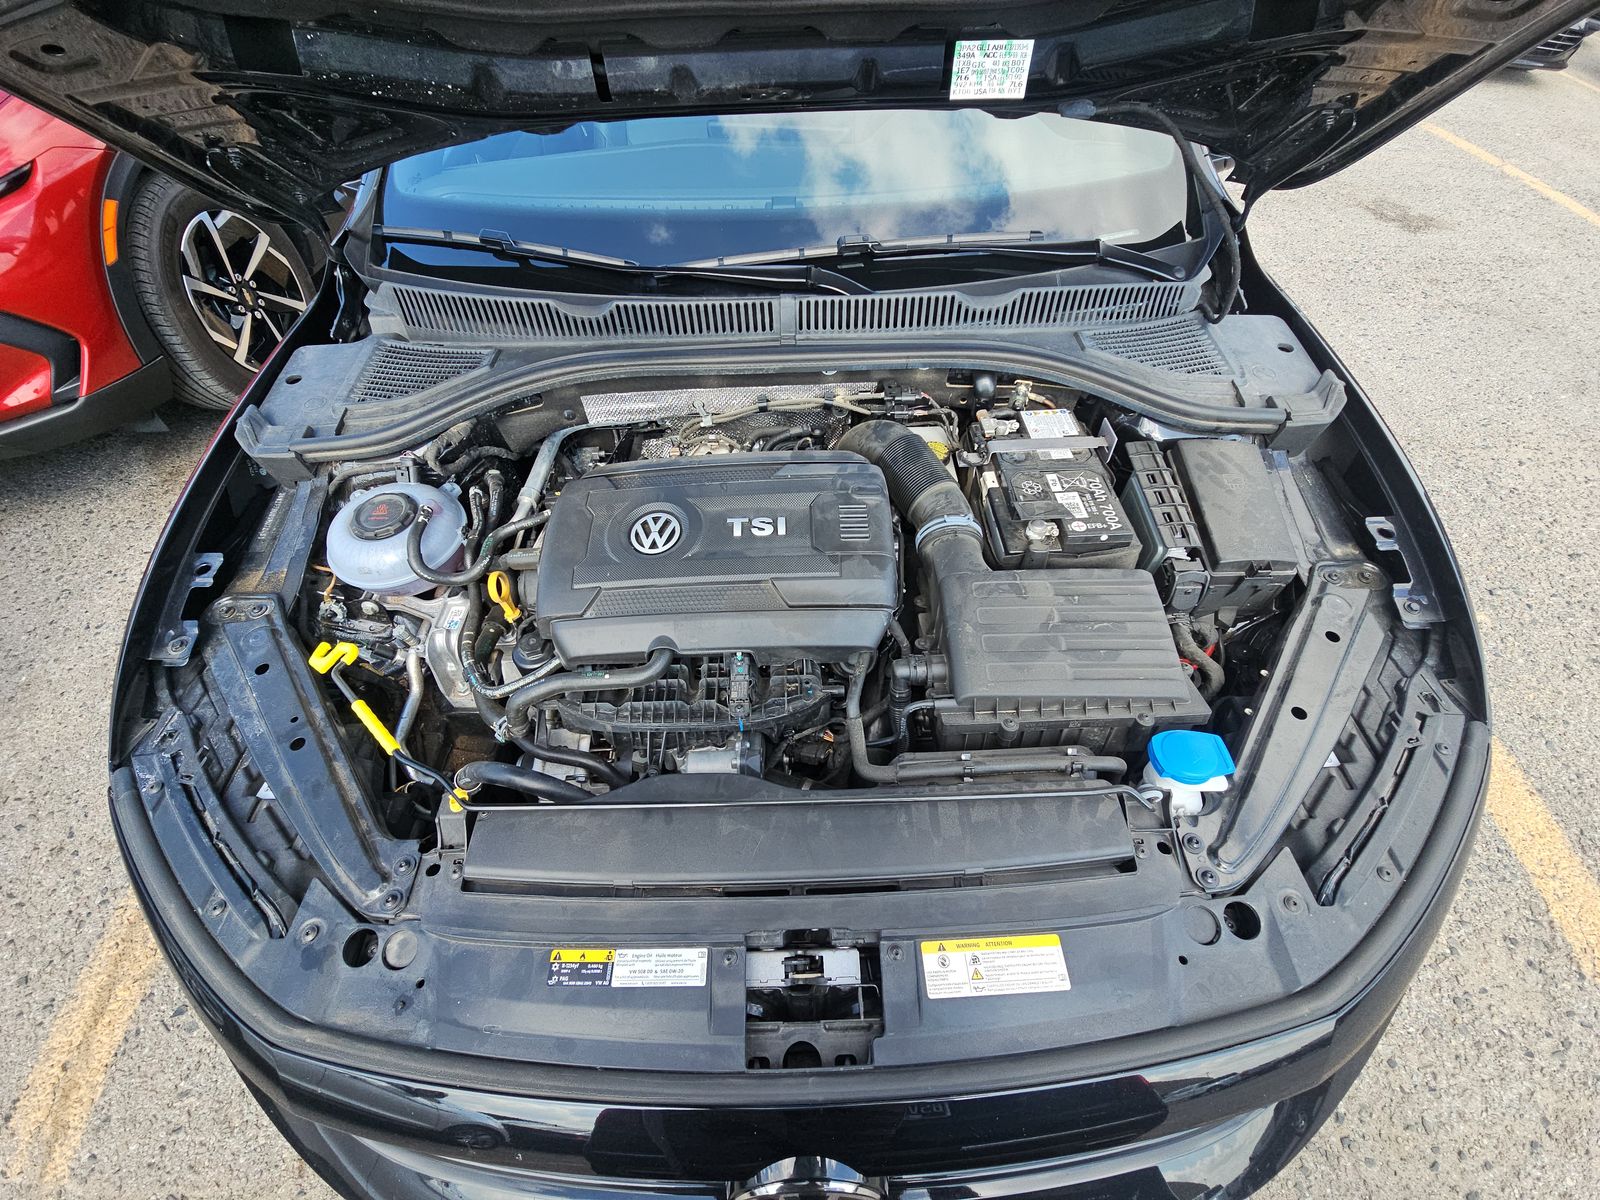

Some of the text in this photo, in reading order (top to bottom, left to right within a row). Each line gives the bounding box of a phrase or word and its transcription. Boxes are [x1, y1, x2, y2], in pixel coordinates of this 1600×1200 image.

[1087, 477, 1108, 502] 70Ah
[1099, 503, 1123, 531] 700A
[726, 516, 787, 537] TSI
[985, 940, 1013, 948] ATTENTION
